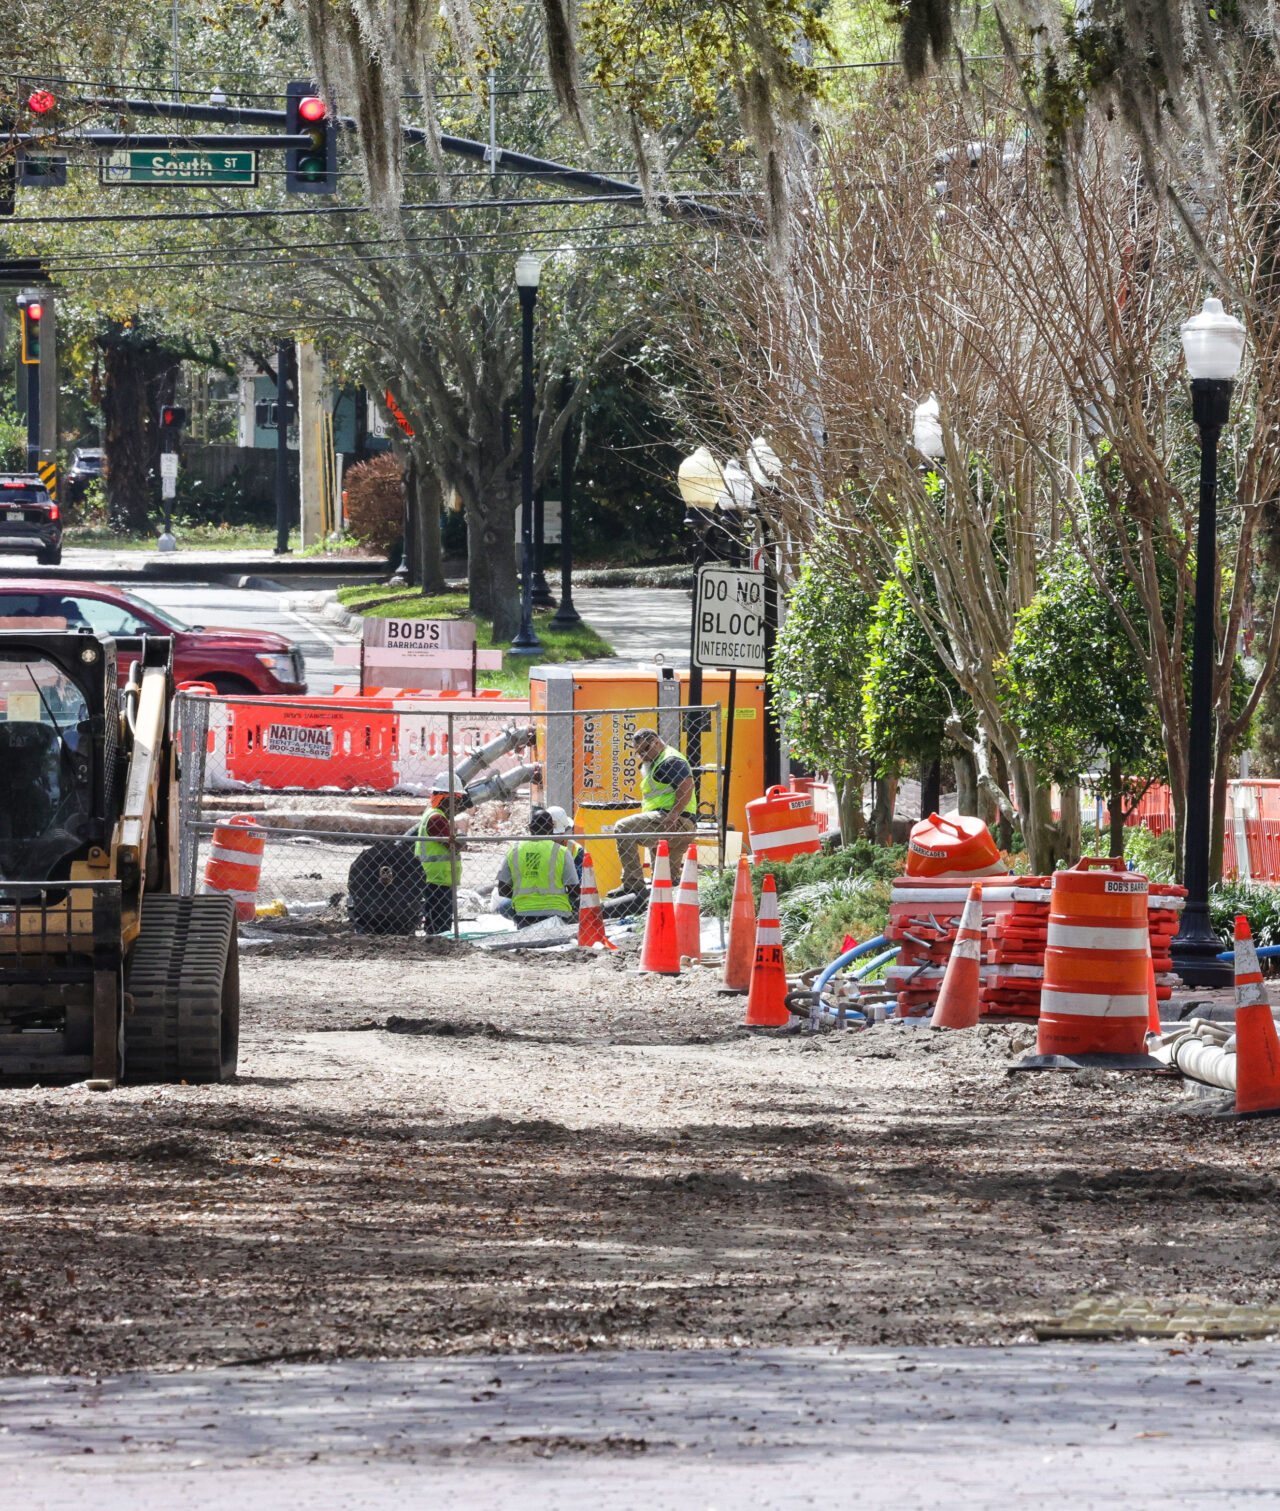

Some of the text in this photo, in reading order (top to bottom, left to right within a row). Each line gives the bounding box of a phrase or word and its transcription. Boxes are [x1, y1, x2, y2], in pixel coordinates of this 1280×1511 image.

[151, 156, 238, 177] South ST
[704, 579, 764, 604] DO NO
[388, 621, 440, 641] BOB'S
[269, 738, 332, 751] RENT-A-FENCE
[270, 724, 331, 746] NATIONAL
[1107, 882, 1129, 892] BOB'S
